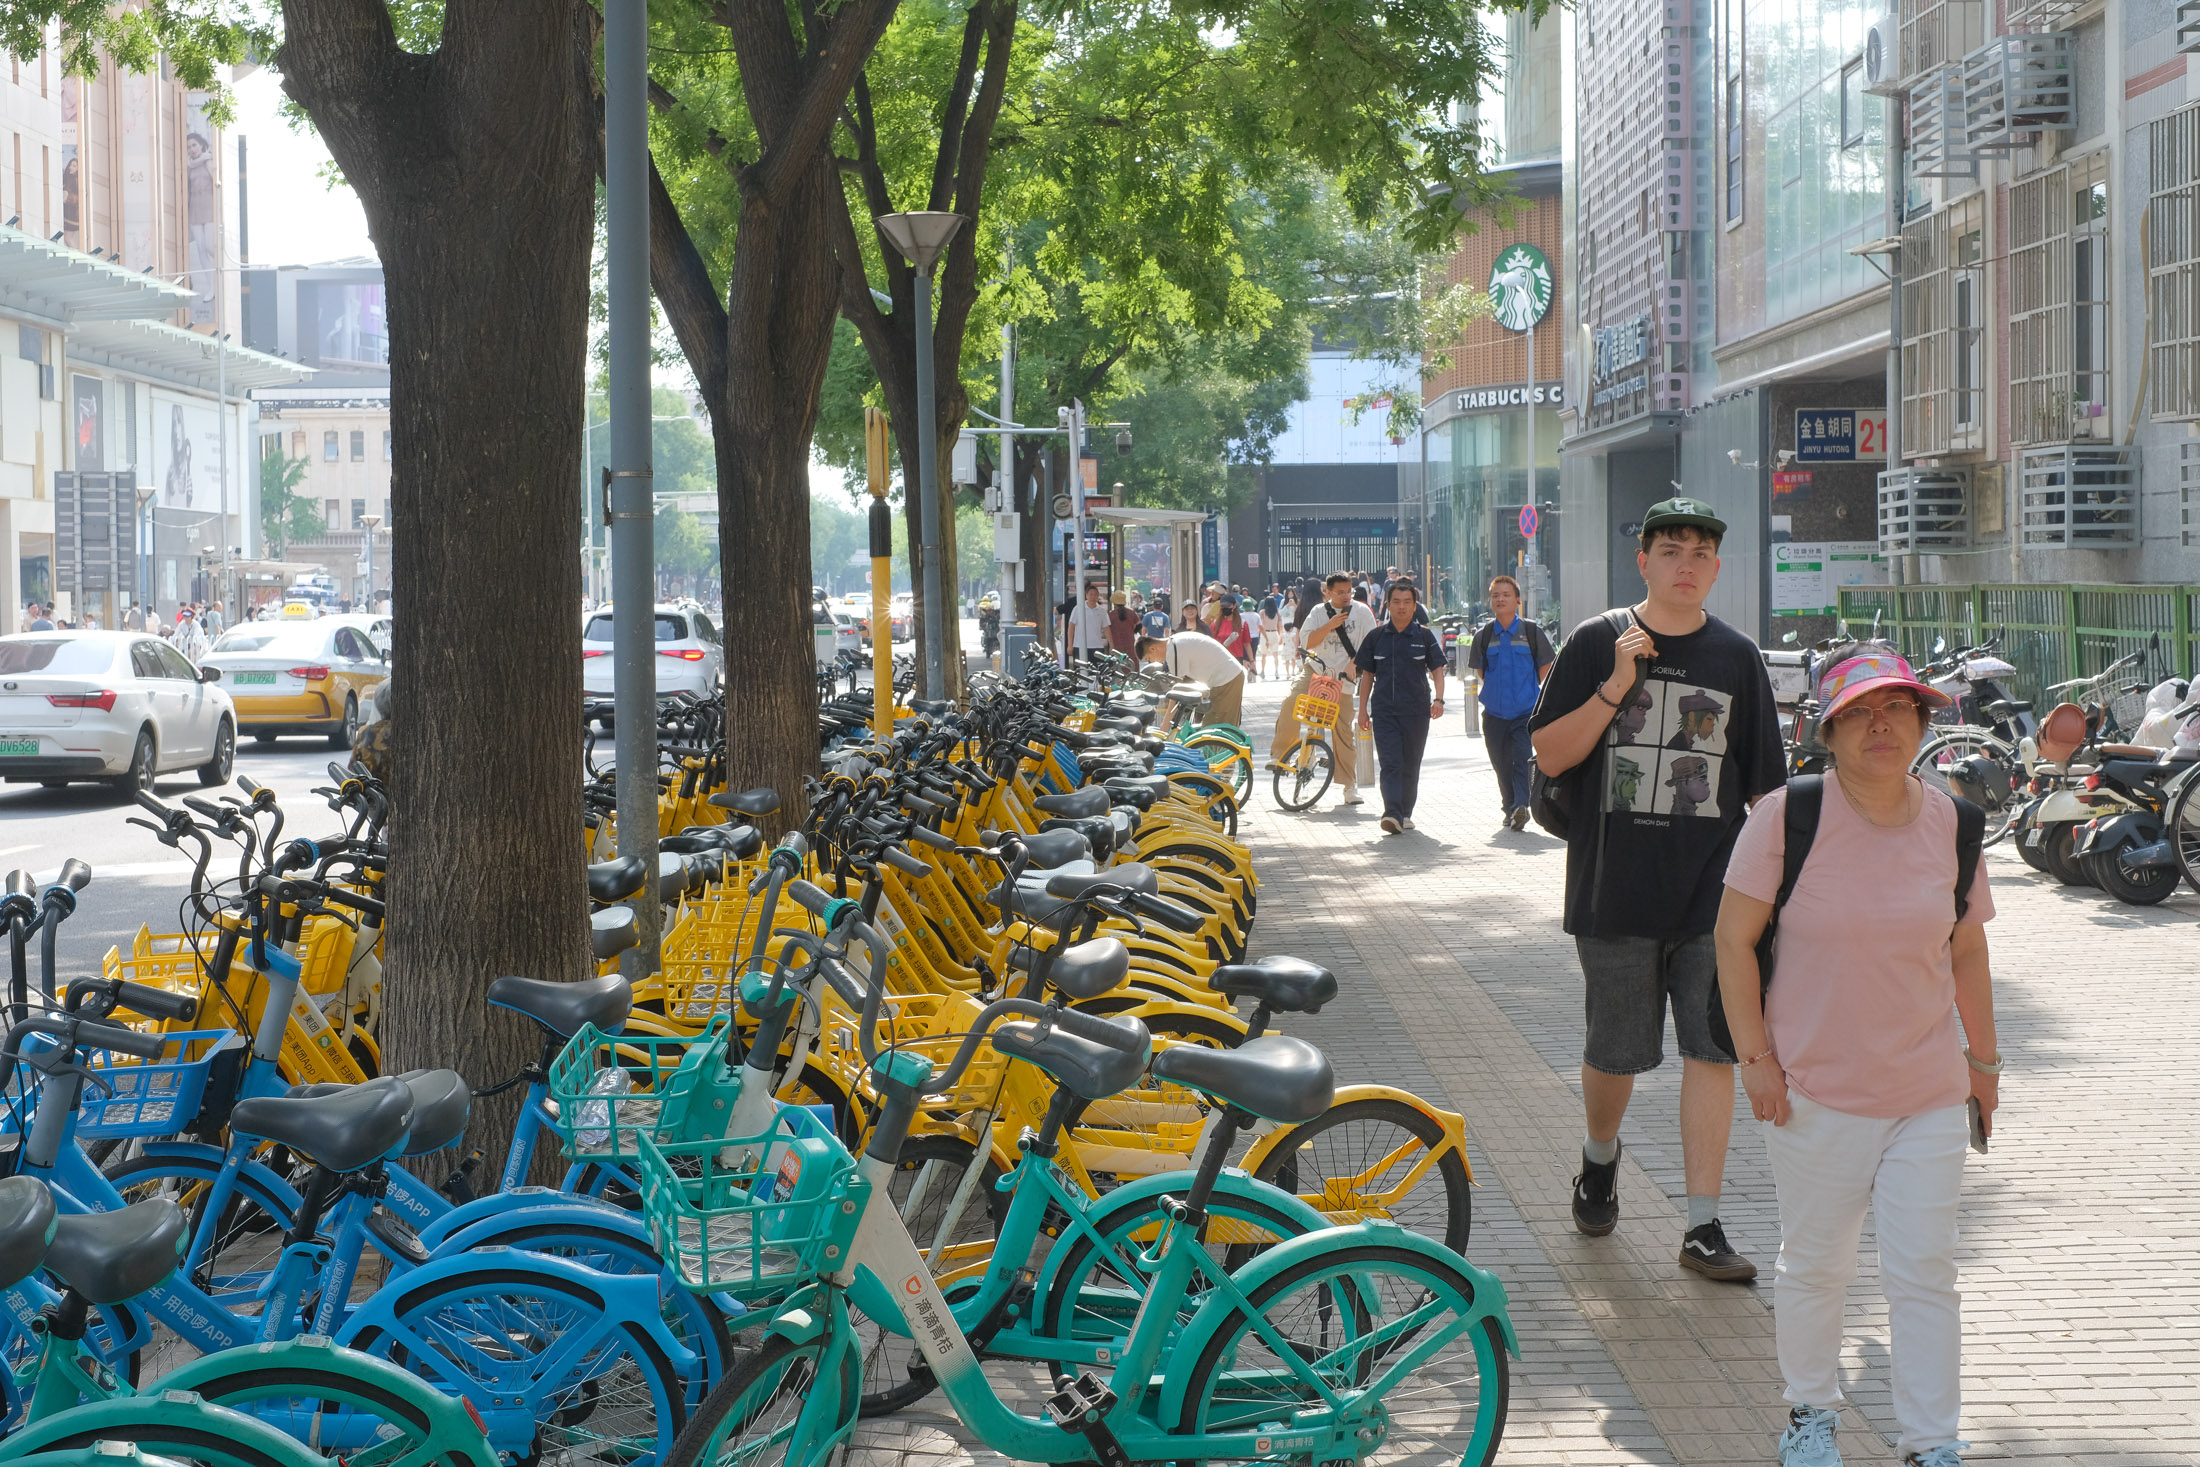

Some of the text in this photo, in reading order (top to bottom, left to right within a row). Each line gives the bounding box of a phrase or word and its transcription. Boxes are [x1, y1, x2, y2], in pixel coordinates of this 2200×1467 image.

[1457, 385, 1564, 410] STARBUCKS C
[1800, 417, 1852, 439] 金鱼胡同
[1860, 418, 1887, 453] 21
[1803, 445, 1850, 454] JINYU HUTONG
[1650, 666, 1687, 678] GORILLAZ
[1633, 817, 1671, 828] DEMON DAYS
[303, 1014, 320, 1033] 美团
[326, 1046, 343, 1065] 微信
[290, 1041, 316, 1076] 美团App
[508, 1138, 527, 1177] DESIGN
[326, 1258, 349, 1304] DESIGN
[162, 1293, 233, 1348] 用哈啰APP
[263, 1290, 288, 1342] DESIGN
[914, 1297, 954, 1355] 滴滴青桔
[1273, 1435, 1315, 1449] 滴滴青桔
